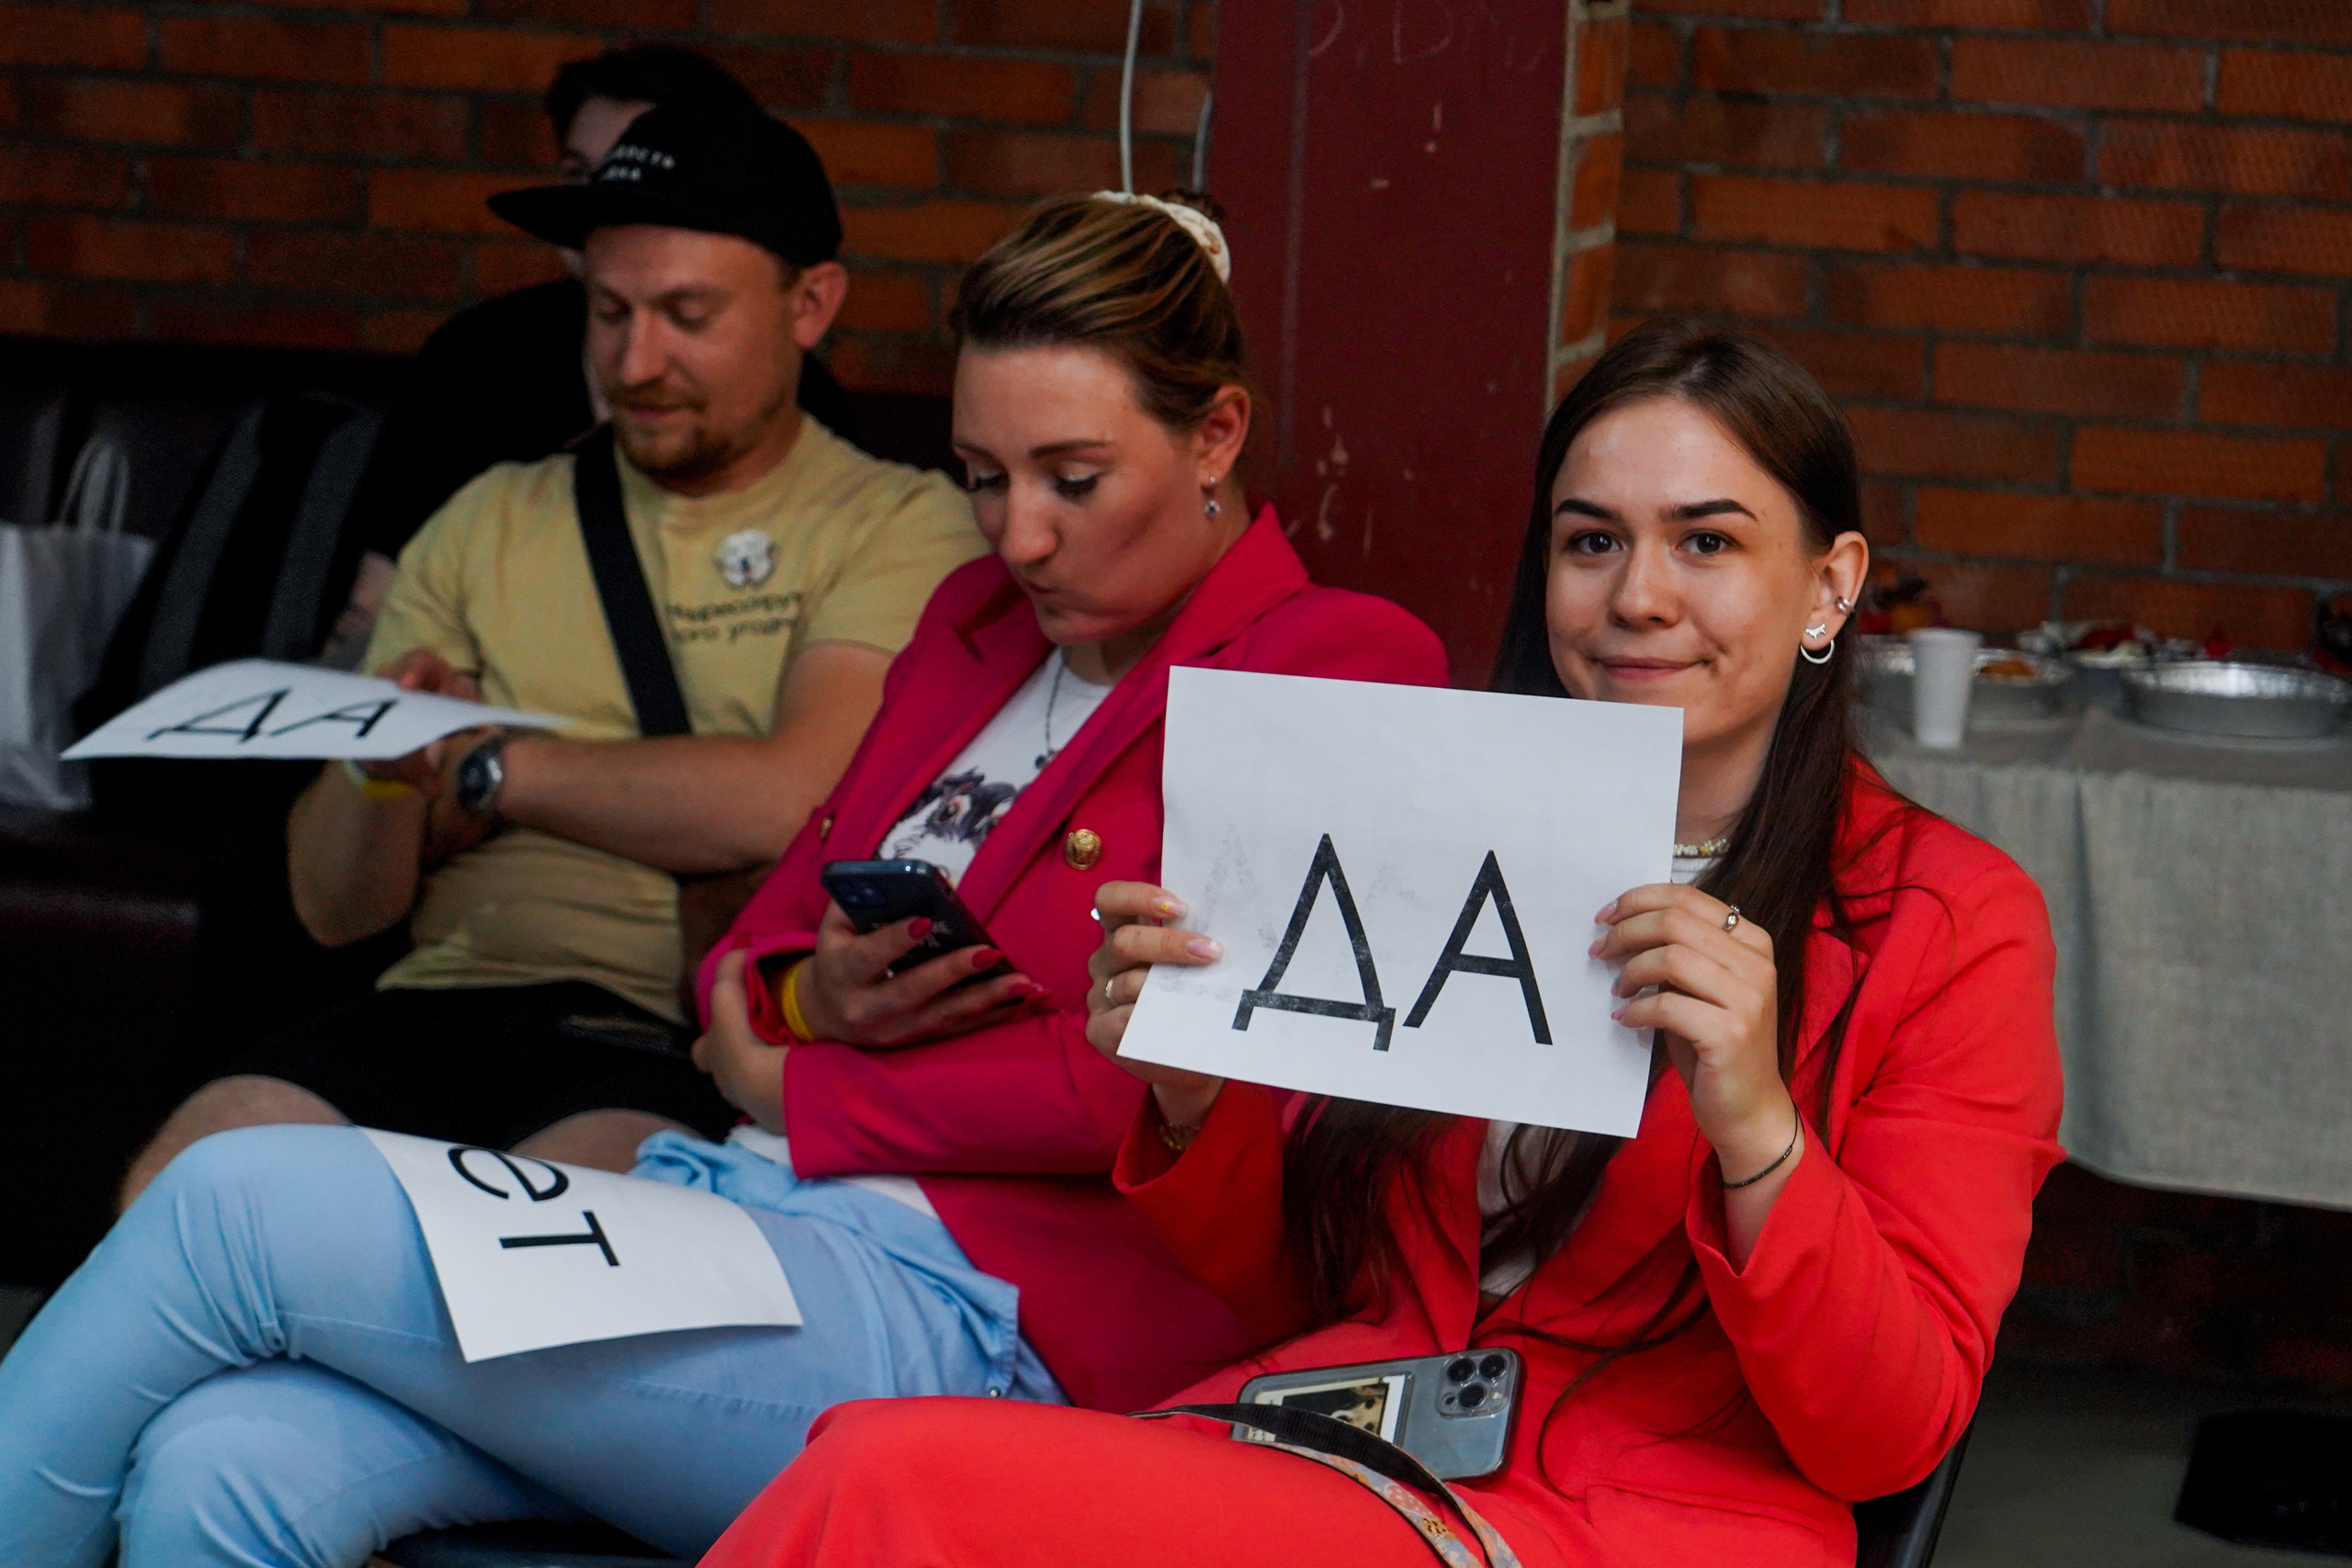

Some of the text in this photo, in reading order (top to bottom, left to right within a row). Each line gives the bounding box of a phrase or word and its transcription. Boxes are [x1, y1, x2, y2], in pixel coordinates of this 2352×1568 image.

[144, 686, 401, 744] ДА
[1231, 832, 1553, 1053] ДА
[447, 1146, 620, 1267] ет
